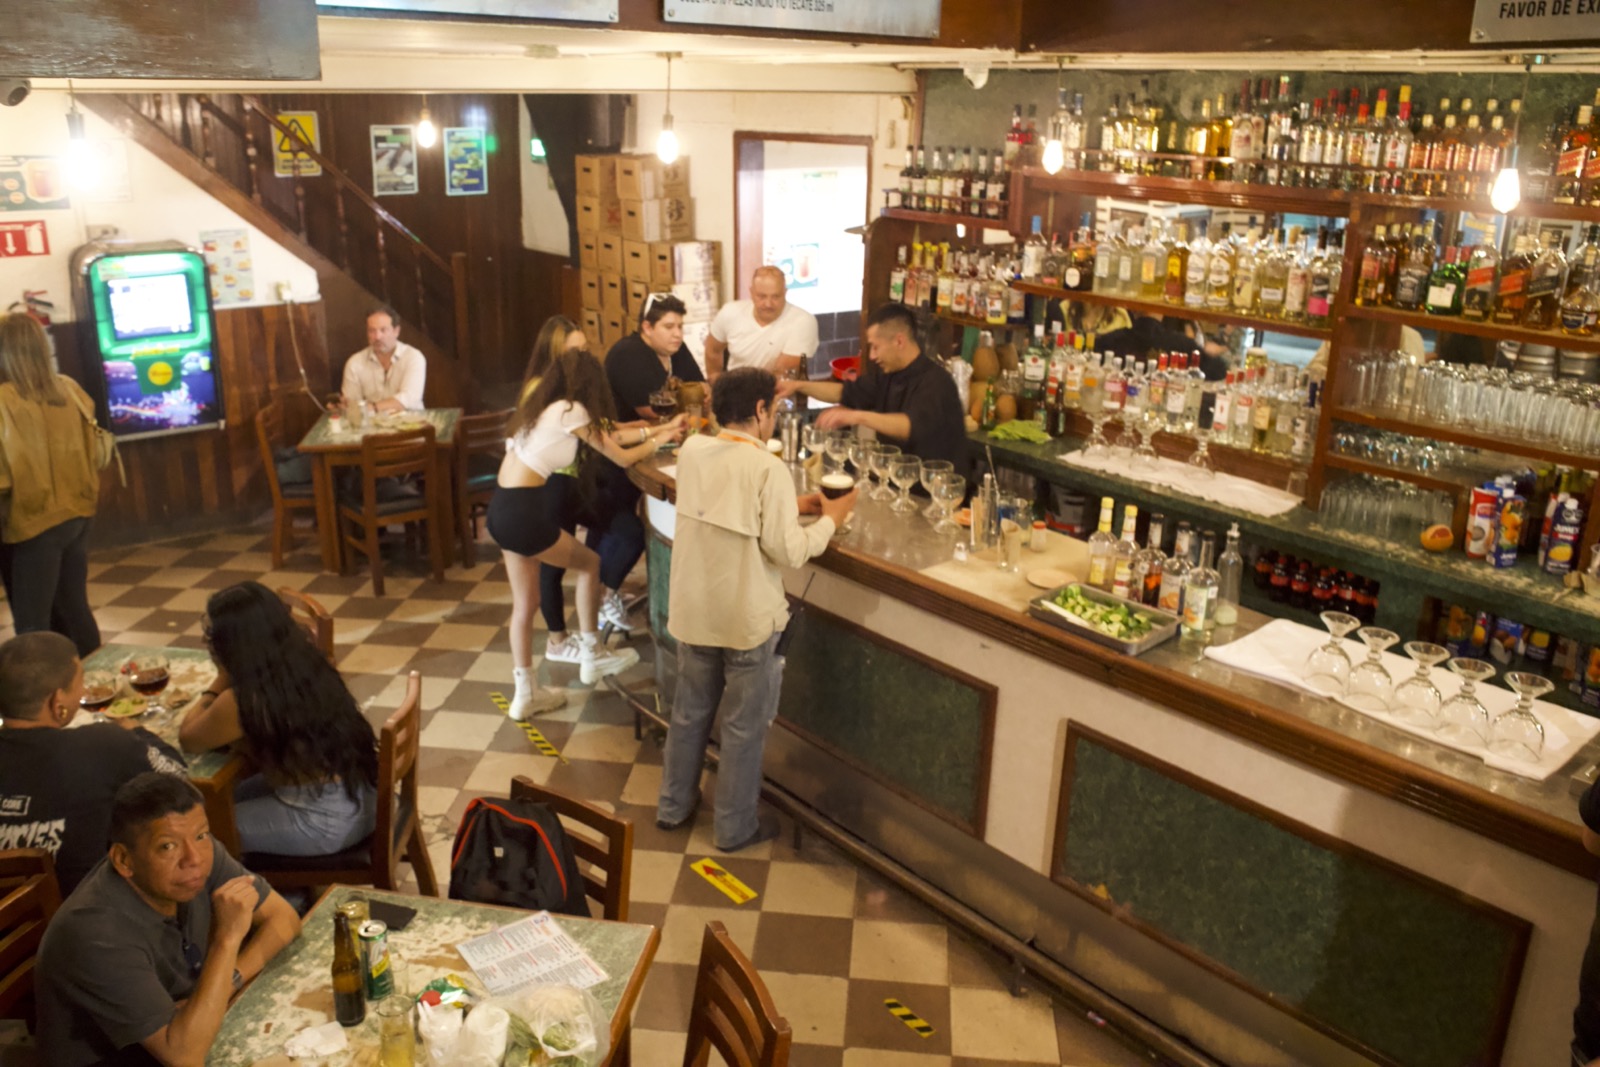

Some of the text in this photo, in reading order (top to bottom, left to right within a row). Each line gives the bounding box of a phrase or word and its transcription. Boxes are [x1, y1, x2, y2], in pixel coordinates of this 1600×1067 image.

[789, 0, 813, 11] TECATE
[1499, 0, 1547, 18] FAVOR
[1551, 0, 1572, 16] DE
